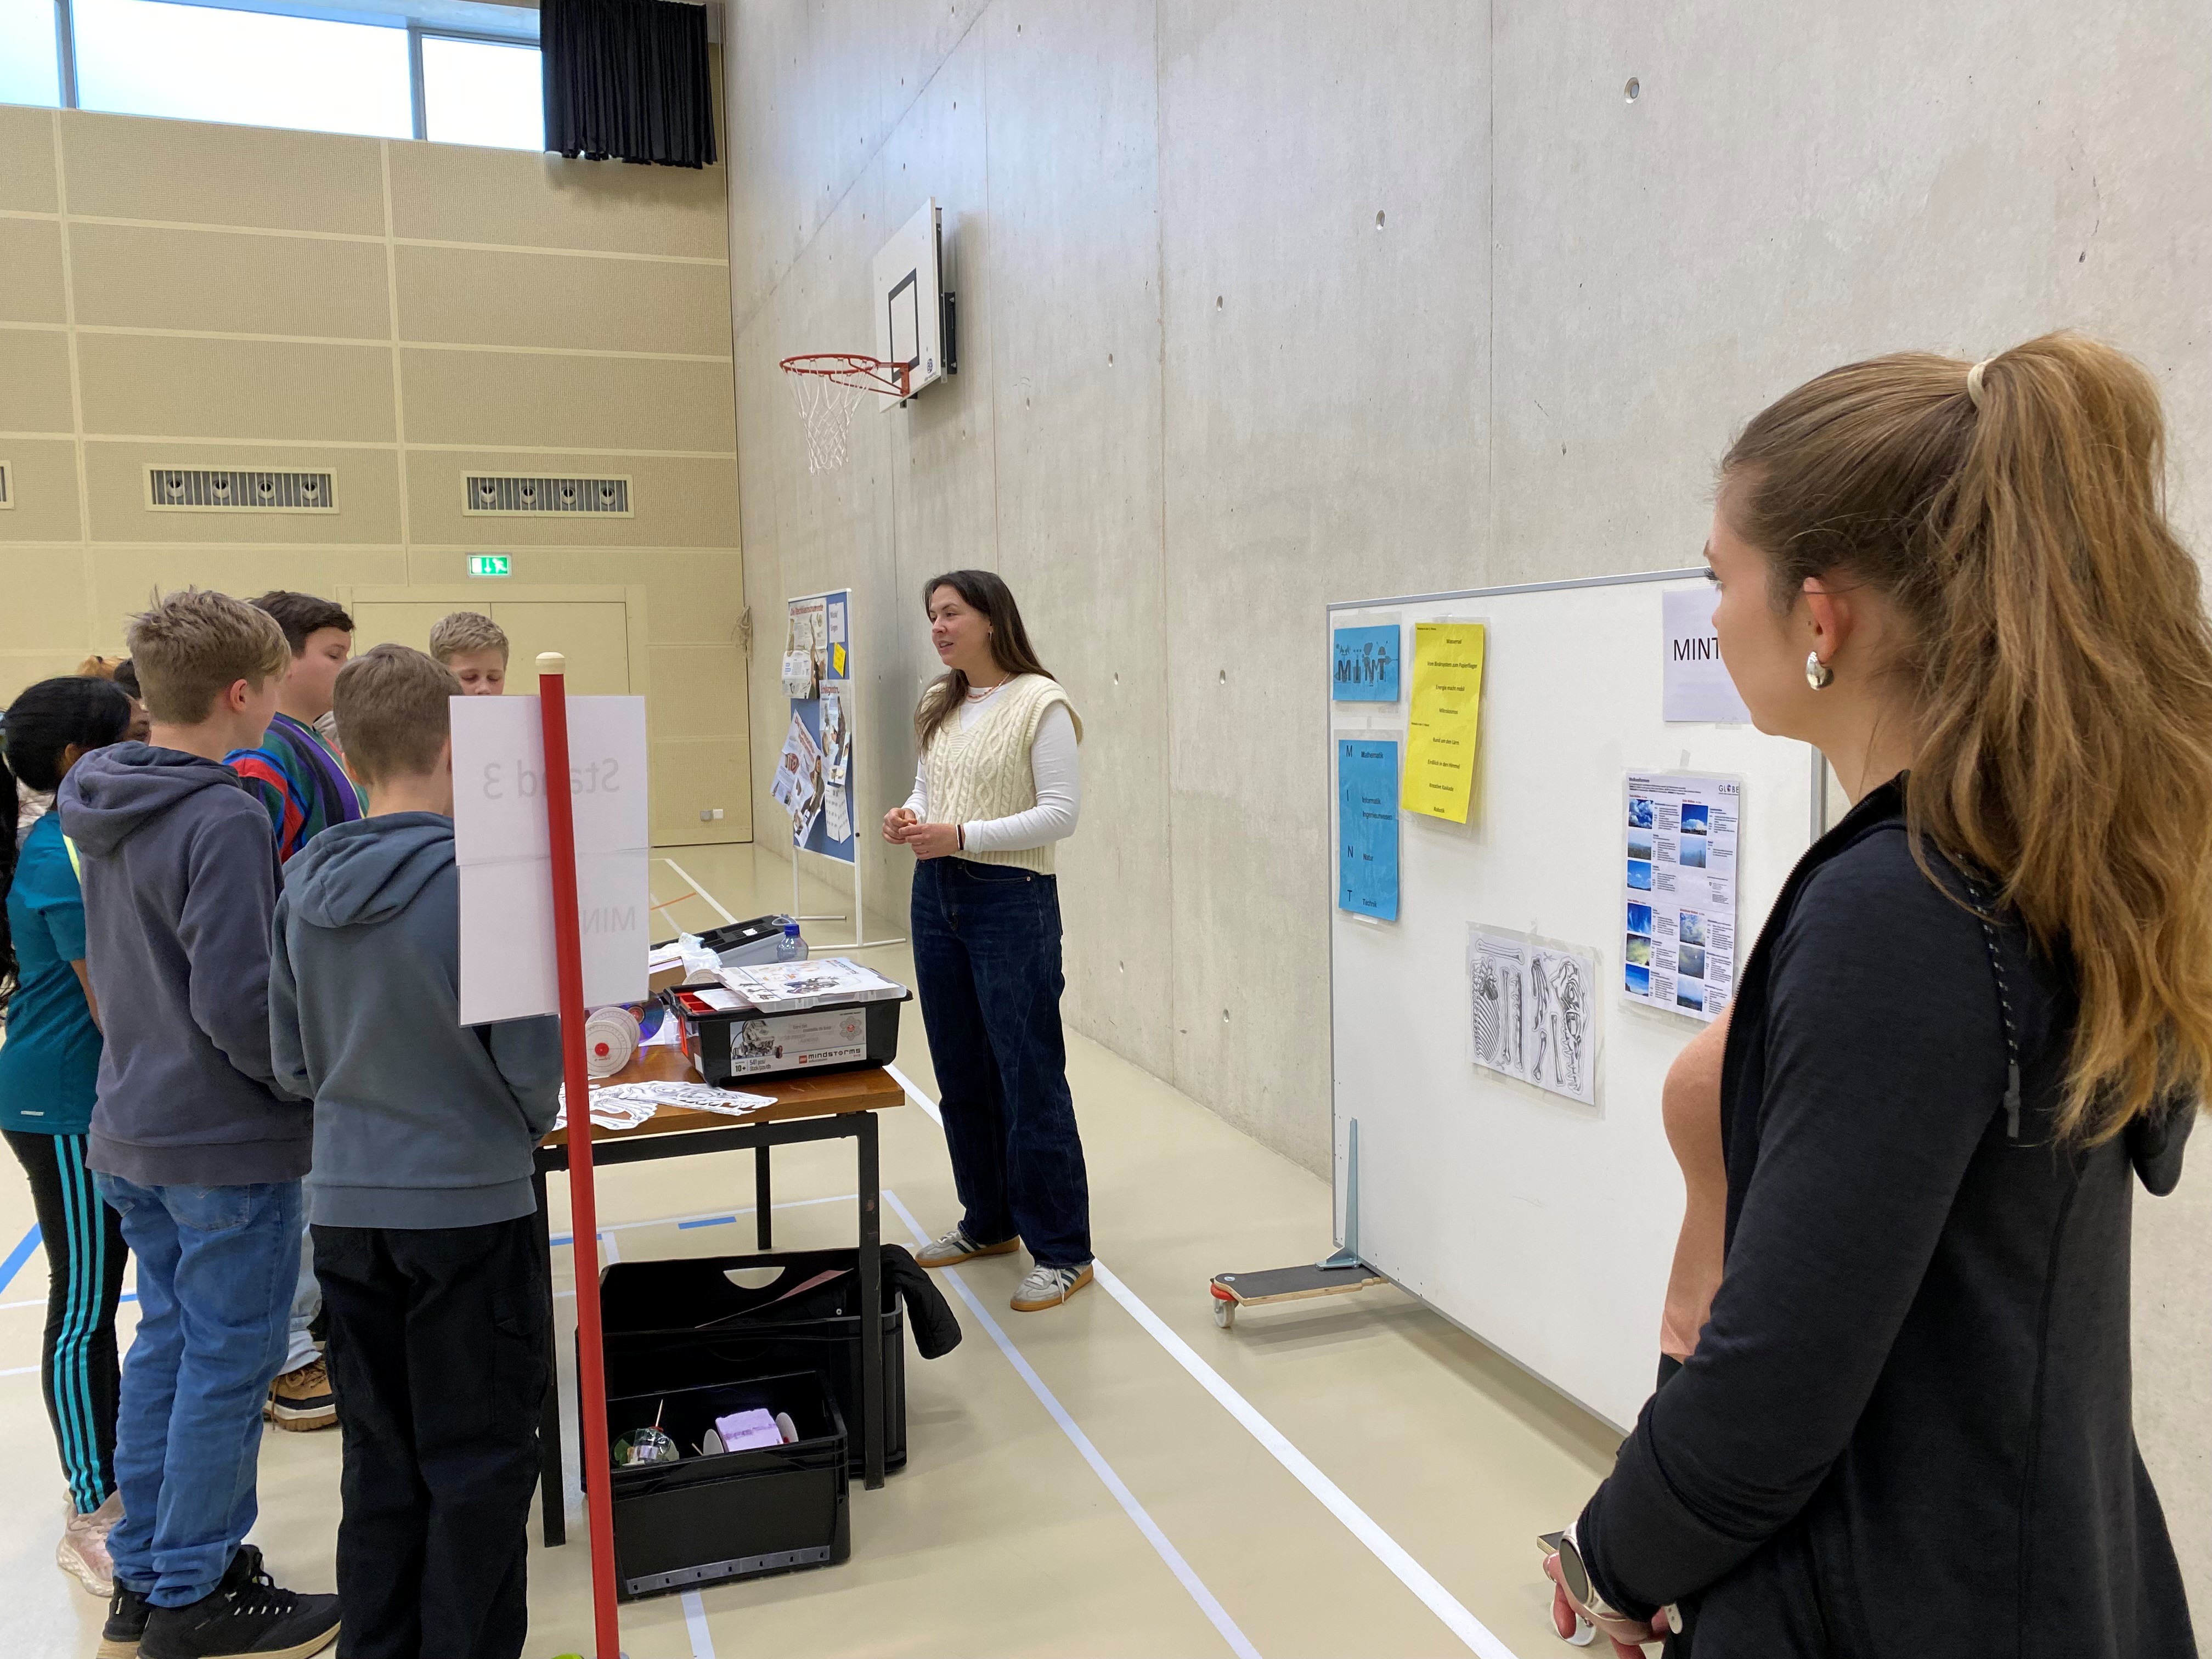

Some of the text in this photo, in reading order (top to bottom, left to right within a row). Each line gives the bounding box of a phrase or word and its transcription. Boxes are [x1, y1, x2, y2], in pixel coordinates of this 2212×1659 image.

[1674, 637, 1719, 661] MINT
[1339, 658, 1386, 681] MINT
[1346, 745, 1352, 757] M
[1347, 789, 1381, 805] I Informatik
[1363, 811, 1392, 820] Ingenieurwesen
[1347, 845, 1353, 857] N
[1347, 890, 1377, 908] T Technik
